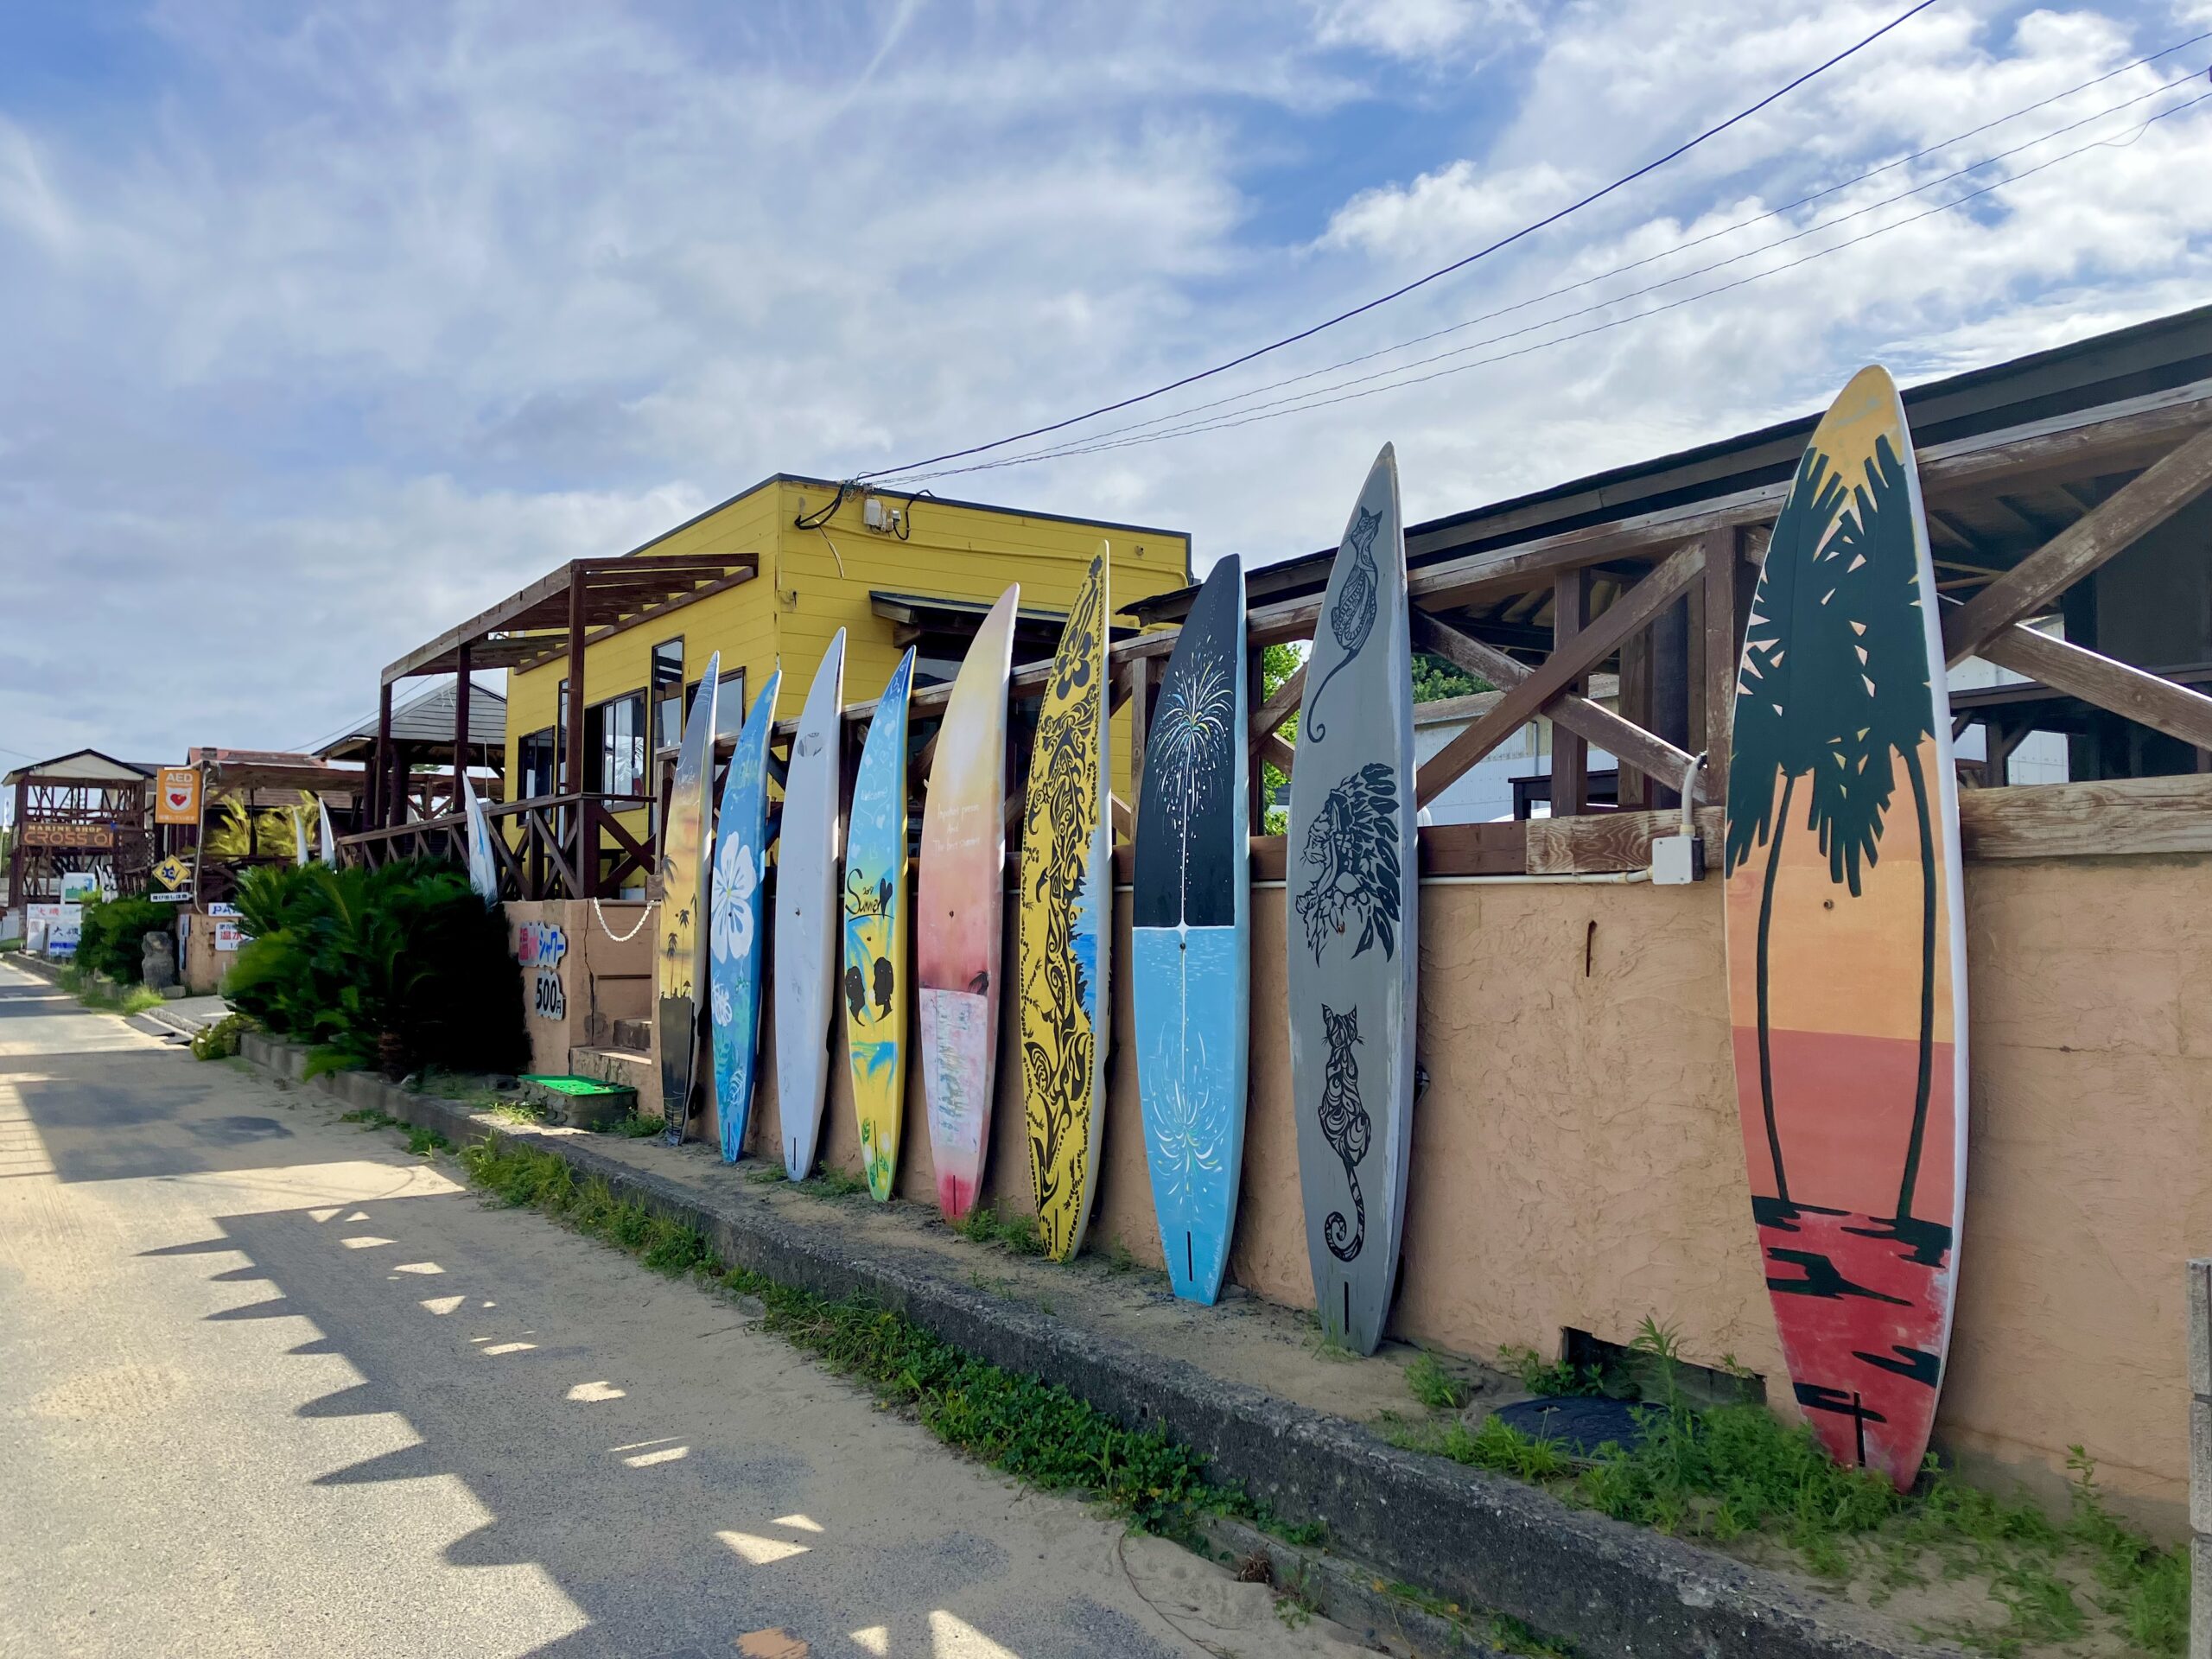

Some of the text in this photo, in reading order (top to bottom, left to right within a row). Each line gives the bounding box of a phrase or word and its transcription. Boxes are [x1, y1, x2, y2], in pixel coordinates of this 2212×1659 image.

[166, 772, 194, 783] AED
[23, 831, 87, 846] CROSS
[536, 977, 563, 1014] 500円
